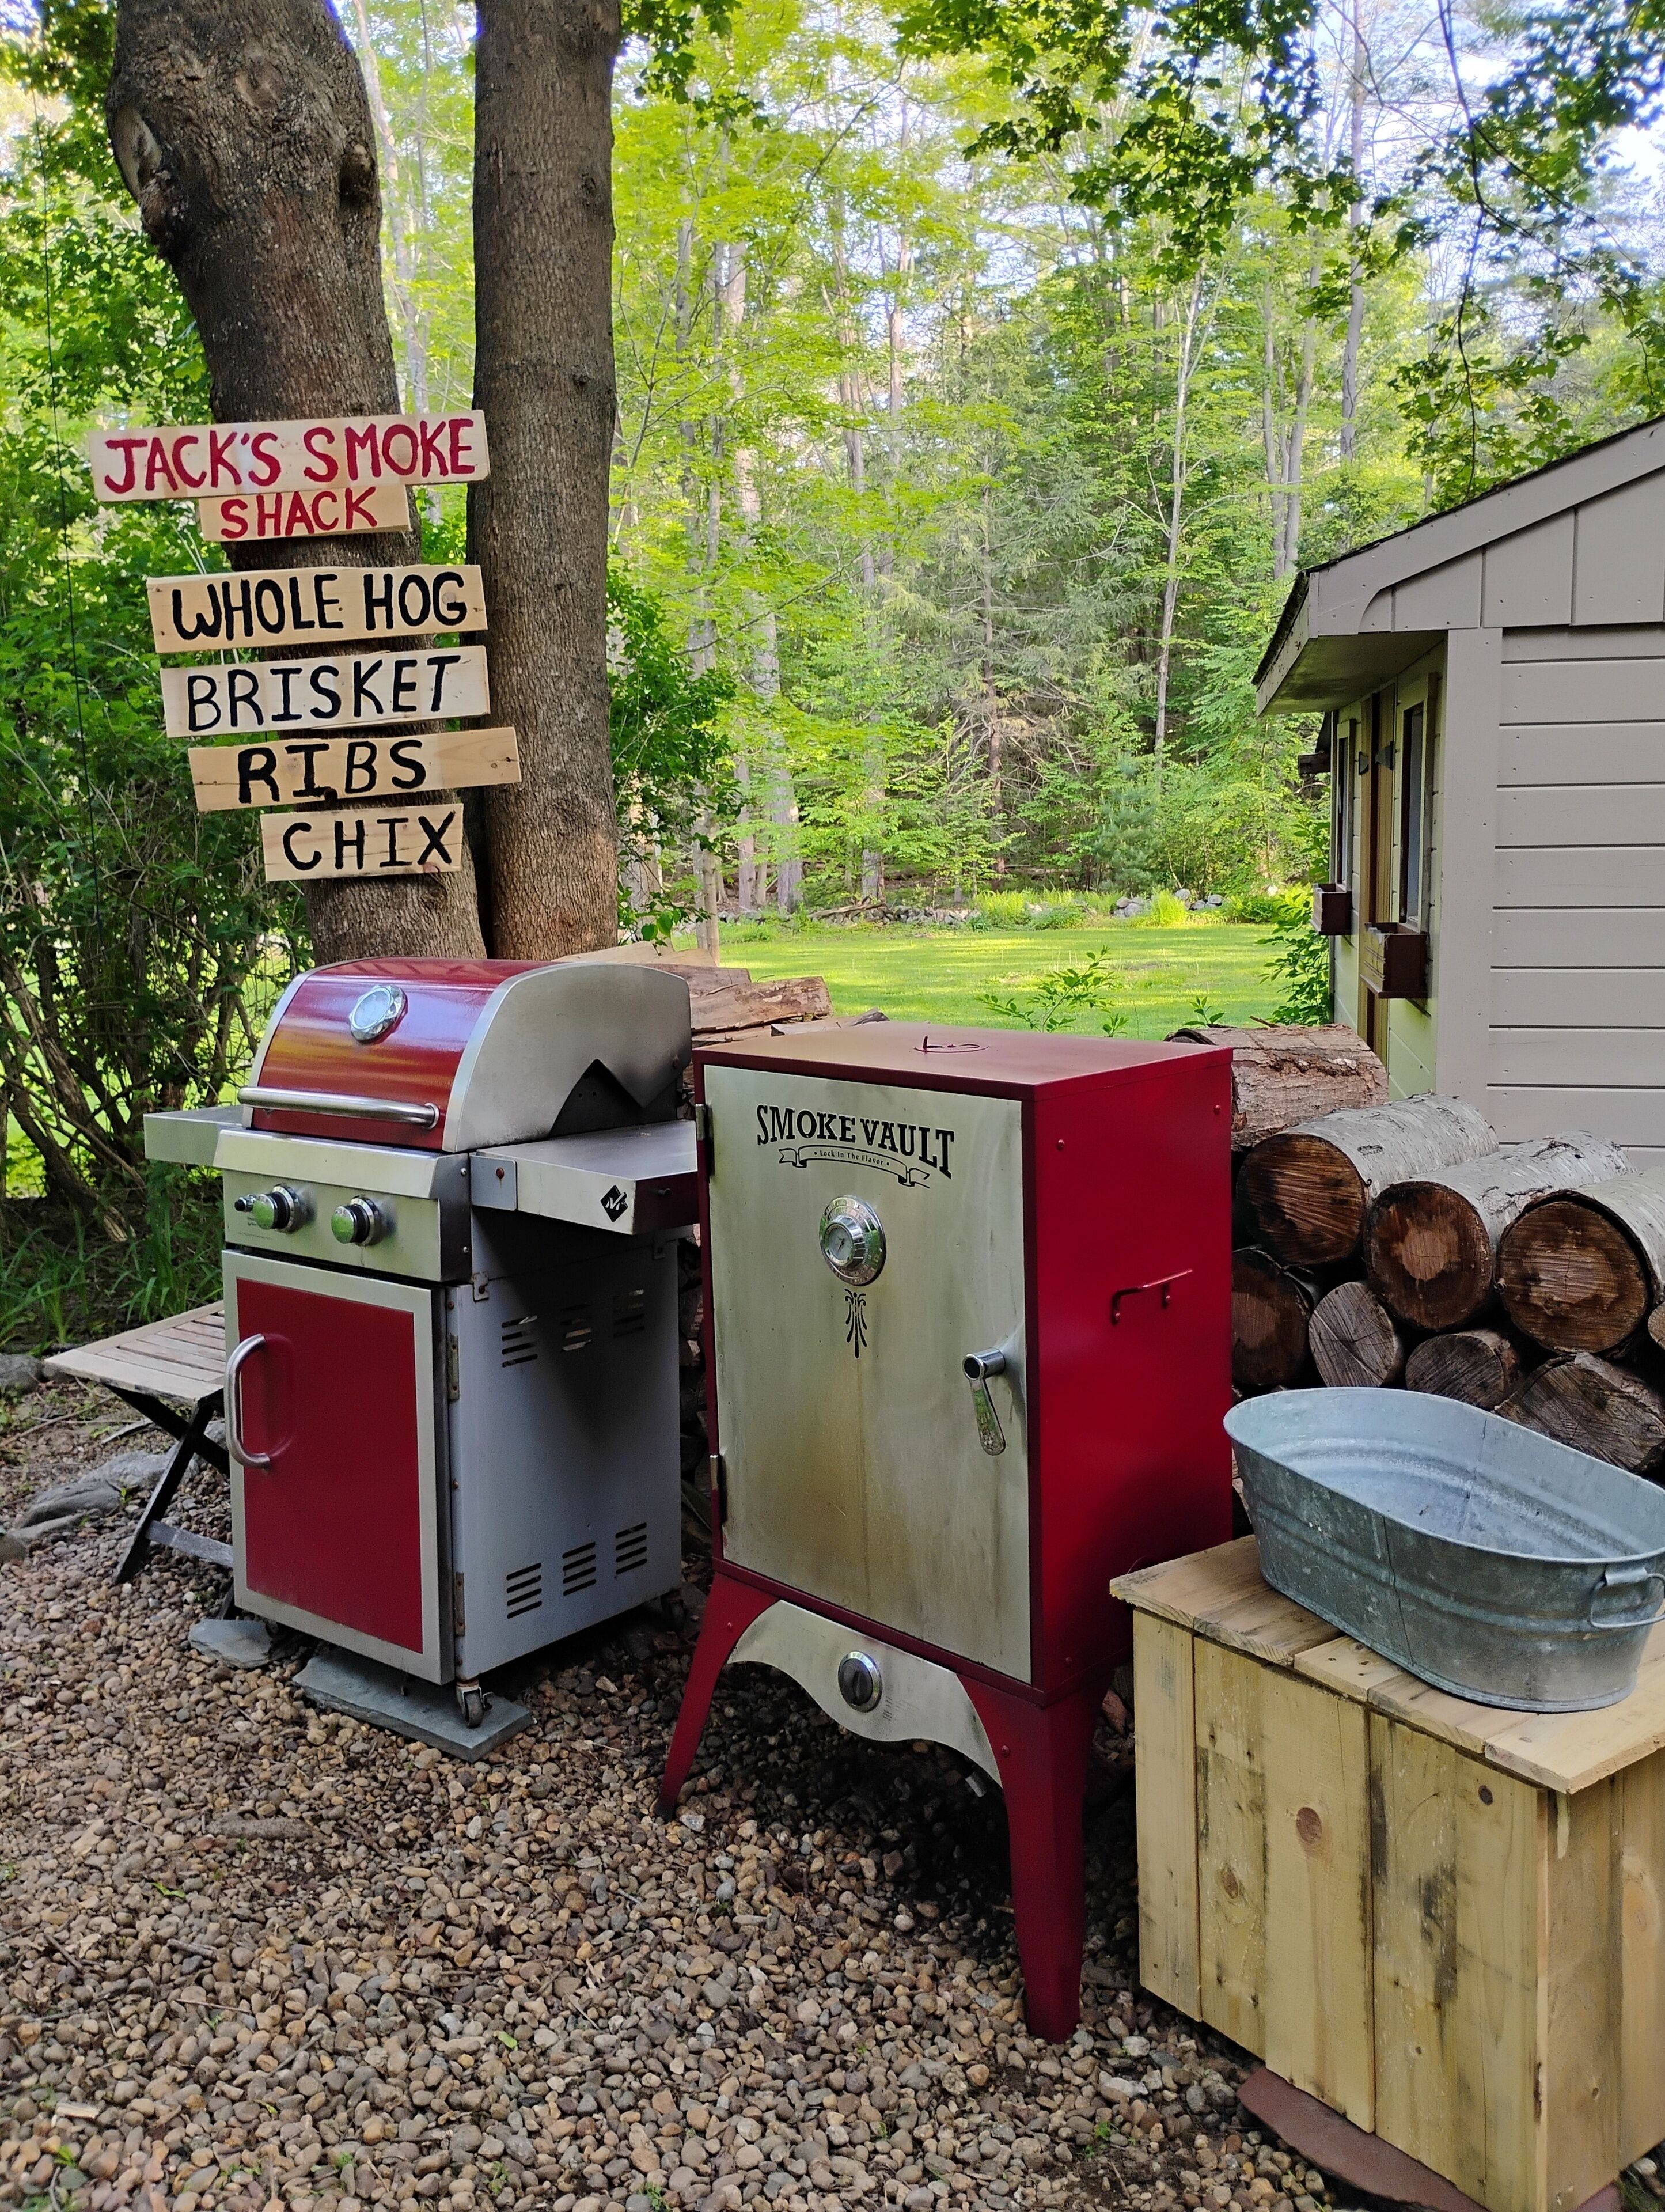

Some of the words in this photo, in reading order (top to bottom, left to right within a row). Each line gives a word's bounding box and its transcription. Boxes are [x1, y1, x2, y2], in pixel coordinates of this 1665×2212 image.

[104, 430, 282, 494] JACK'S
[304, 418, 475, 483] SMOKE
[221, 486, 377, 539] SHACK
[173, 574, 344, 641] WHOLE
[364, 571, 467, 630] HOG
[187, 655, 461, 732] BRISKET
[238, 739, 427, 804] RIBS
[282, 810, 456, 870] CHIX
[757, 1104, 856, 1145] SMOKE
[860, 1118, 955, 1179] VAULT
[847, 1152, 859, 1160] The
[862, 1154, 883, 1165] Flavor
